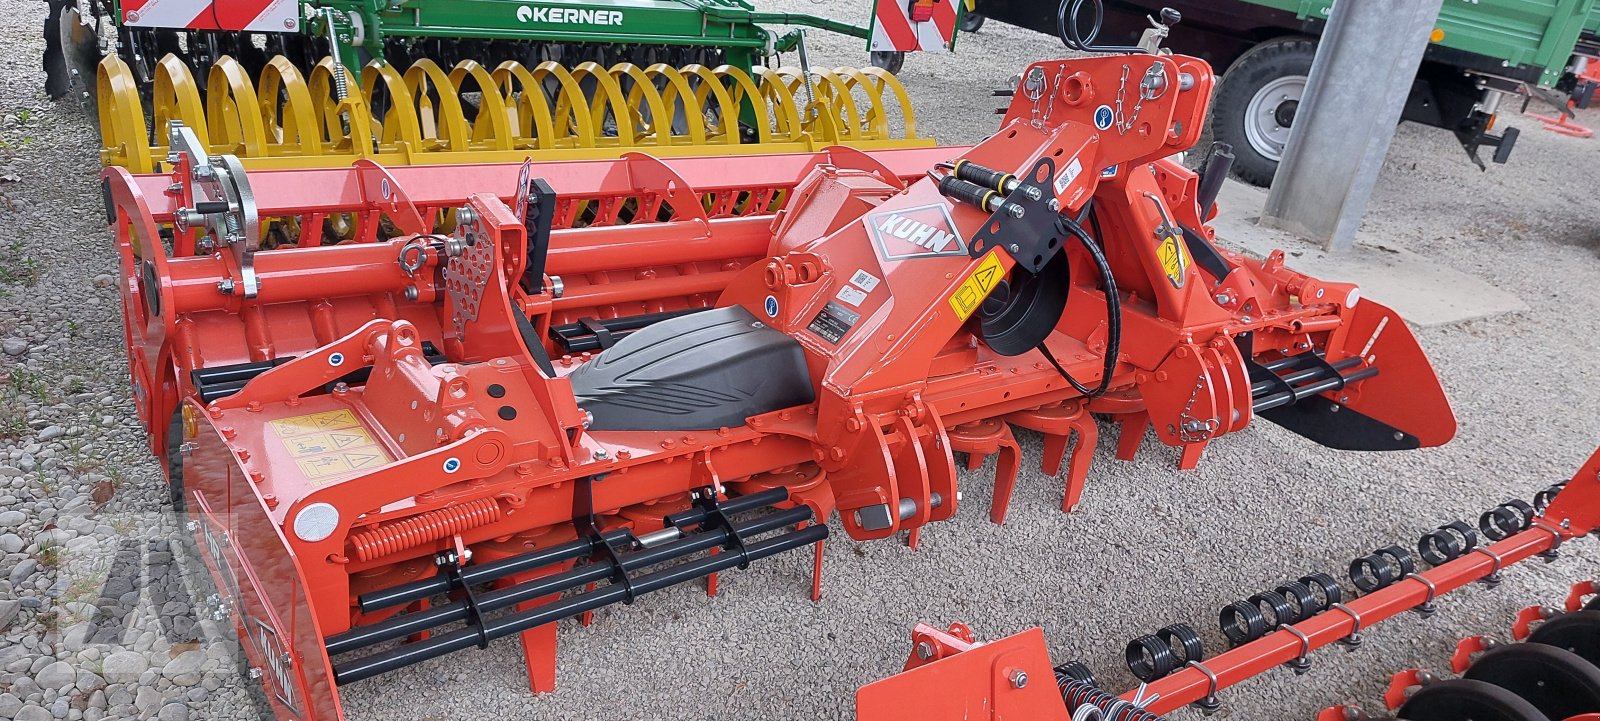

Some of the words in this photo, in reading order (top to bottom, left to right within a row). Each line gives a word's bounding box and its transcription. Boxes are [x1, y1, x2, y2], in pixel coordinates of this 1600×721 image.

[533, 7, 623, 25] KERNER
[879, 213, 955, 253] KUHN
[260, 627, 293, 705] KUHN
